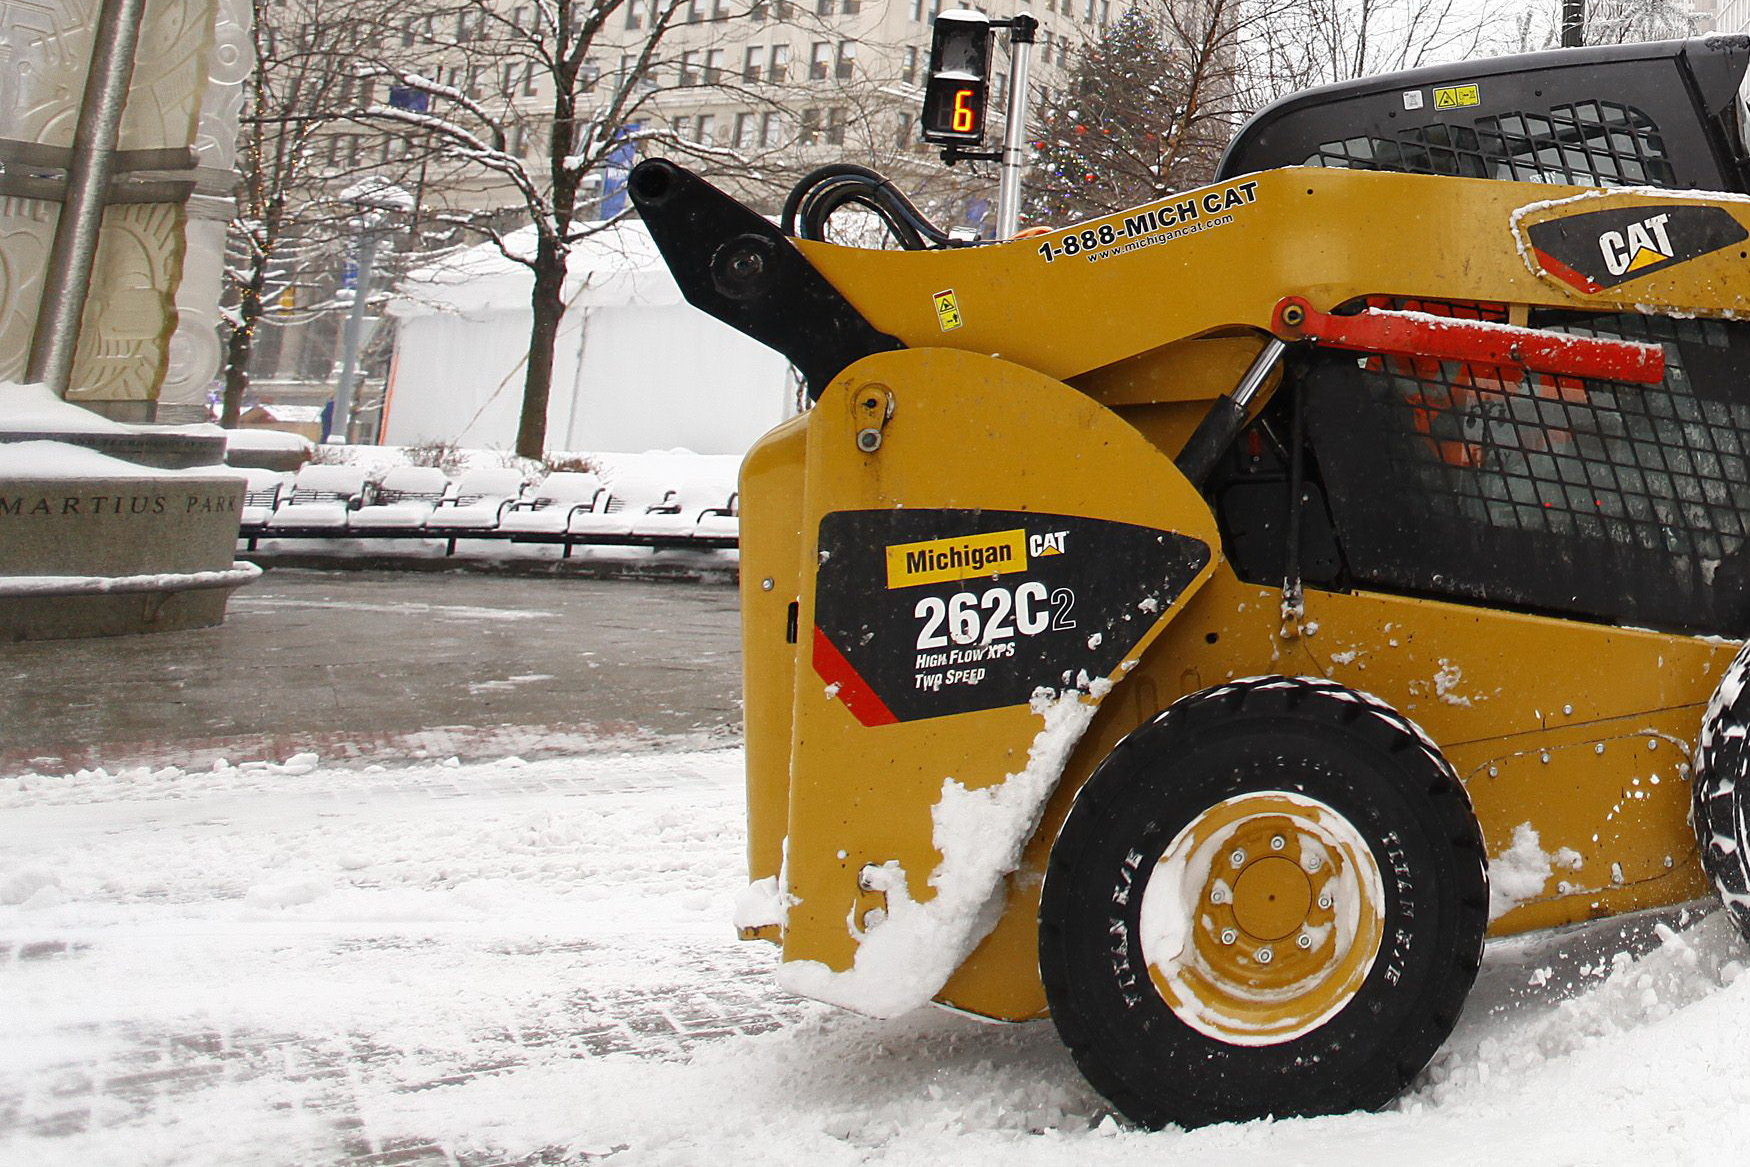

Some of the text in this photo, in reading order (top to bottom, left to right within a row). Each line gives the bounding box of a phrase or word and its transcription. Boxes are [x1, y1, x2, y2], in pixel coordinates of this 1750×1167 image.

[953, 90, 974, 132] 6
[1038, 182, 1258, 264] 1-888-MICH CAT
[1086, 213, 1233, 263] www.michigancat.com
[1599, 213, 1674, 276] CAT
[0, 496, 236, 515] MARTIUS PARK
[906, 532, 1067, 574] Michigan CAT
[915, 653, 948, 669] HIGH
[949, 649, 986, 665] FLOW
